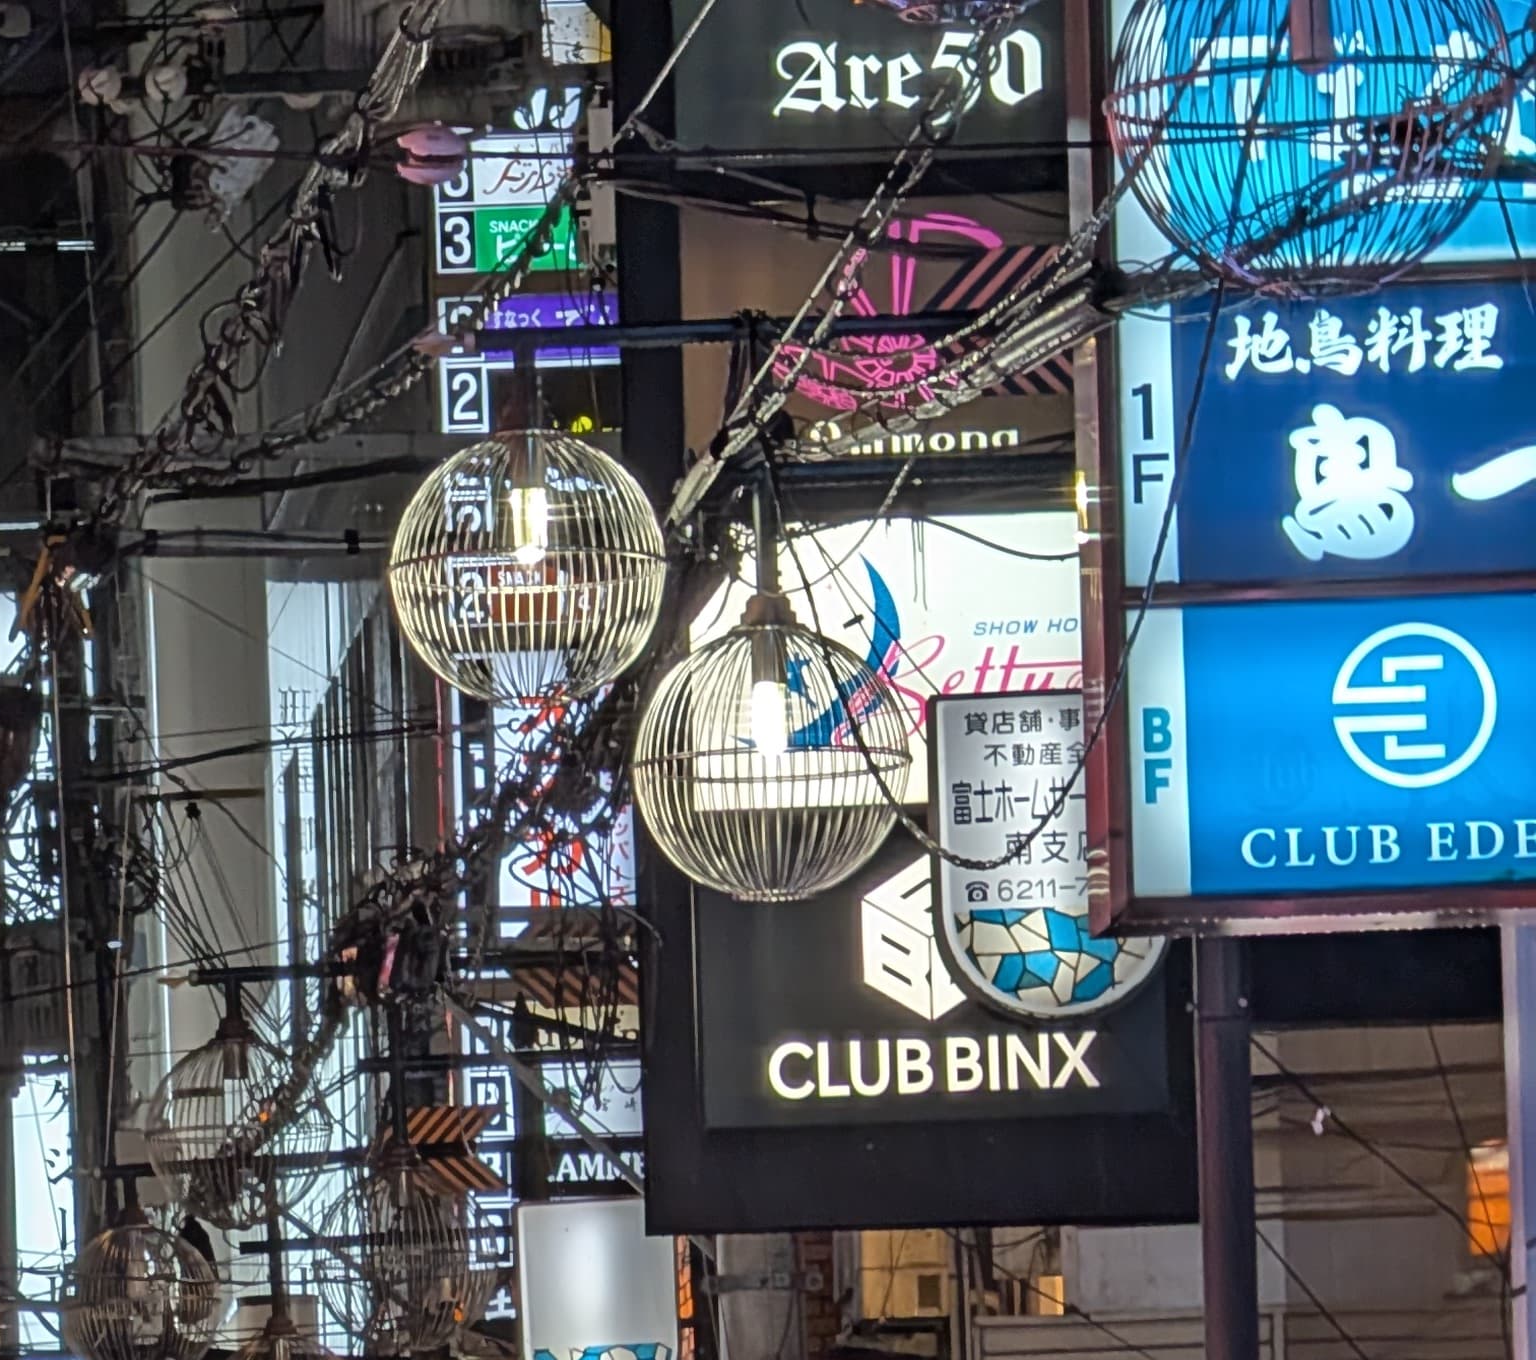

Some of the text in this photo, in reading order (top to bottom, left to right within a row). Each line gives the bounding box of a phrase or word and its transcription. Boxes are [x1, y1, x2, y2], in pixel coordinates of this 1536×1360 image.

[444, 215, 472, 265] 3
[451, 372, 479, 421] 2
[973, 618, 1040, 636] SHOW
[1240, 826, 1401, 868] CLUB
[768, 1029, 1101, 1100] CLUB BINX
